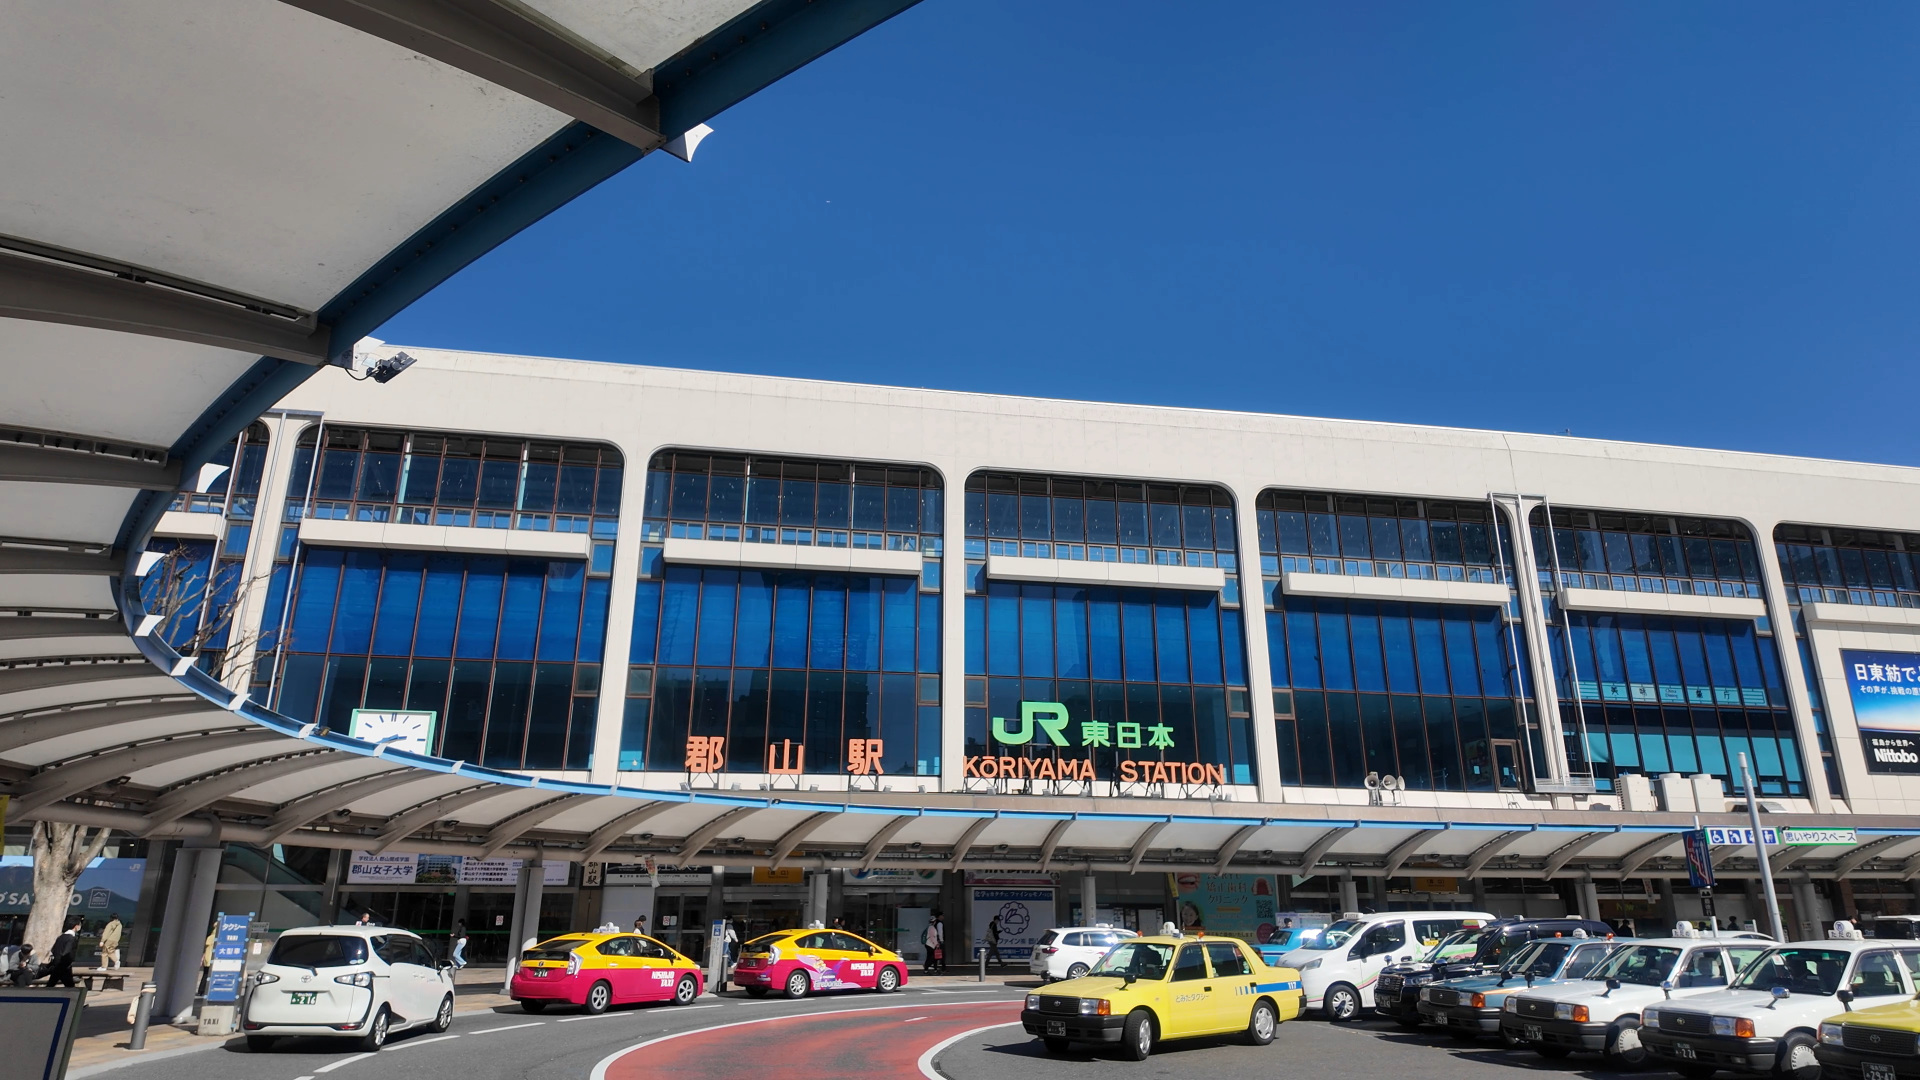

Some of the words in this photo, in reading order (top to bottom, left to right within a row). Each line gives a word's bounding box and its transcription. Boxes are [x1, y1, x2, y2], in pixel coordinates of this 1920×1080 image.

[1854, 663, 1920, 683] 日東紡で
[992, 701, 1070, 747] JR
[1081, 720, 1175, 750] 東日本
[685, 736, 884, 775] 郡山駅
[1873, 748, 1919, 763] Nittobo
[1120, 760, 1225, 785] STATION
[1785, 831, 1857, 842] 思いやりスペース
[352, 864, 413, 875] 郡山女子大学
[1207, 882, 1247, 893] 矯正歯科
[1208, 895, 1248, 904] クリニック
[222, 923, 247, 932] タクシー
[219, 947, 241, 955] 大型車
[660, 979, 675, 987] TAXI
[1288, 981, 1297, 989] 117
[1175, 994, 1210, 1003] とみたタクシー
